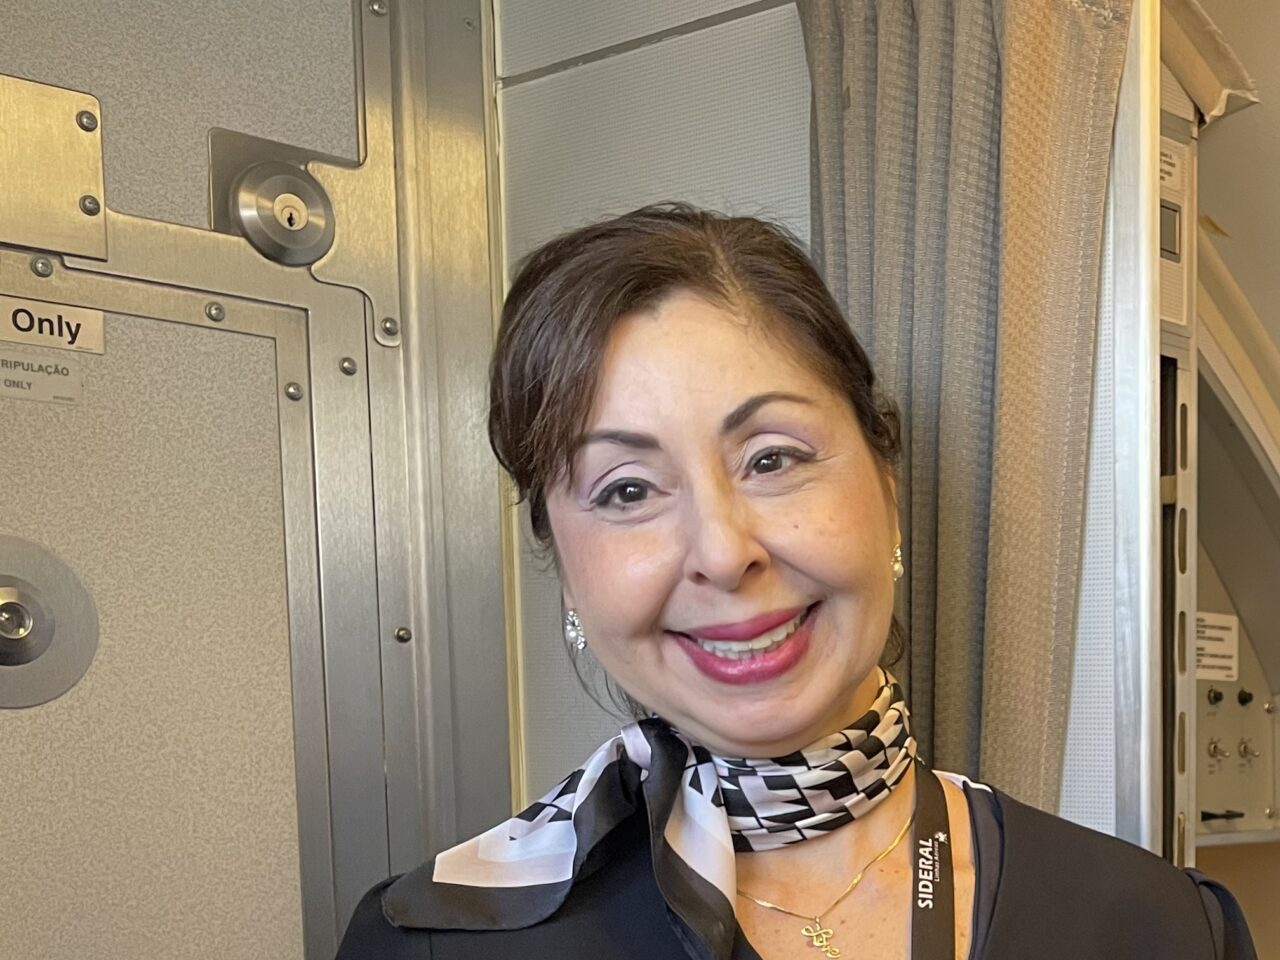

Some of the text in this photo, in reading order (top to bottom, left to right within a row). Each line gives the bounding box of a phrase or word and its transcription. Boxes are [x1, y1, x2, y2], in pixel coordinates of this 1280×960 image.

[11, 308, 82, 345] Only
[0, 359, 69, 376] RIPULAÇÃO
[4, 379, 32, 390] ONLY
[918, 838, 933, 909] SIDERAL
